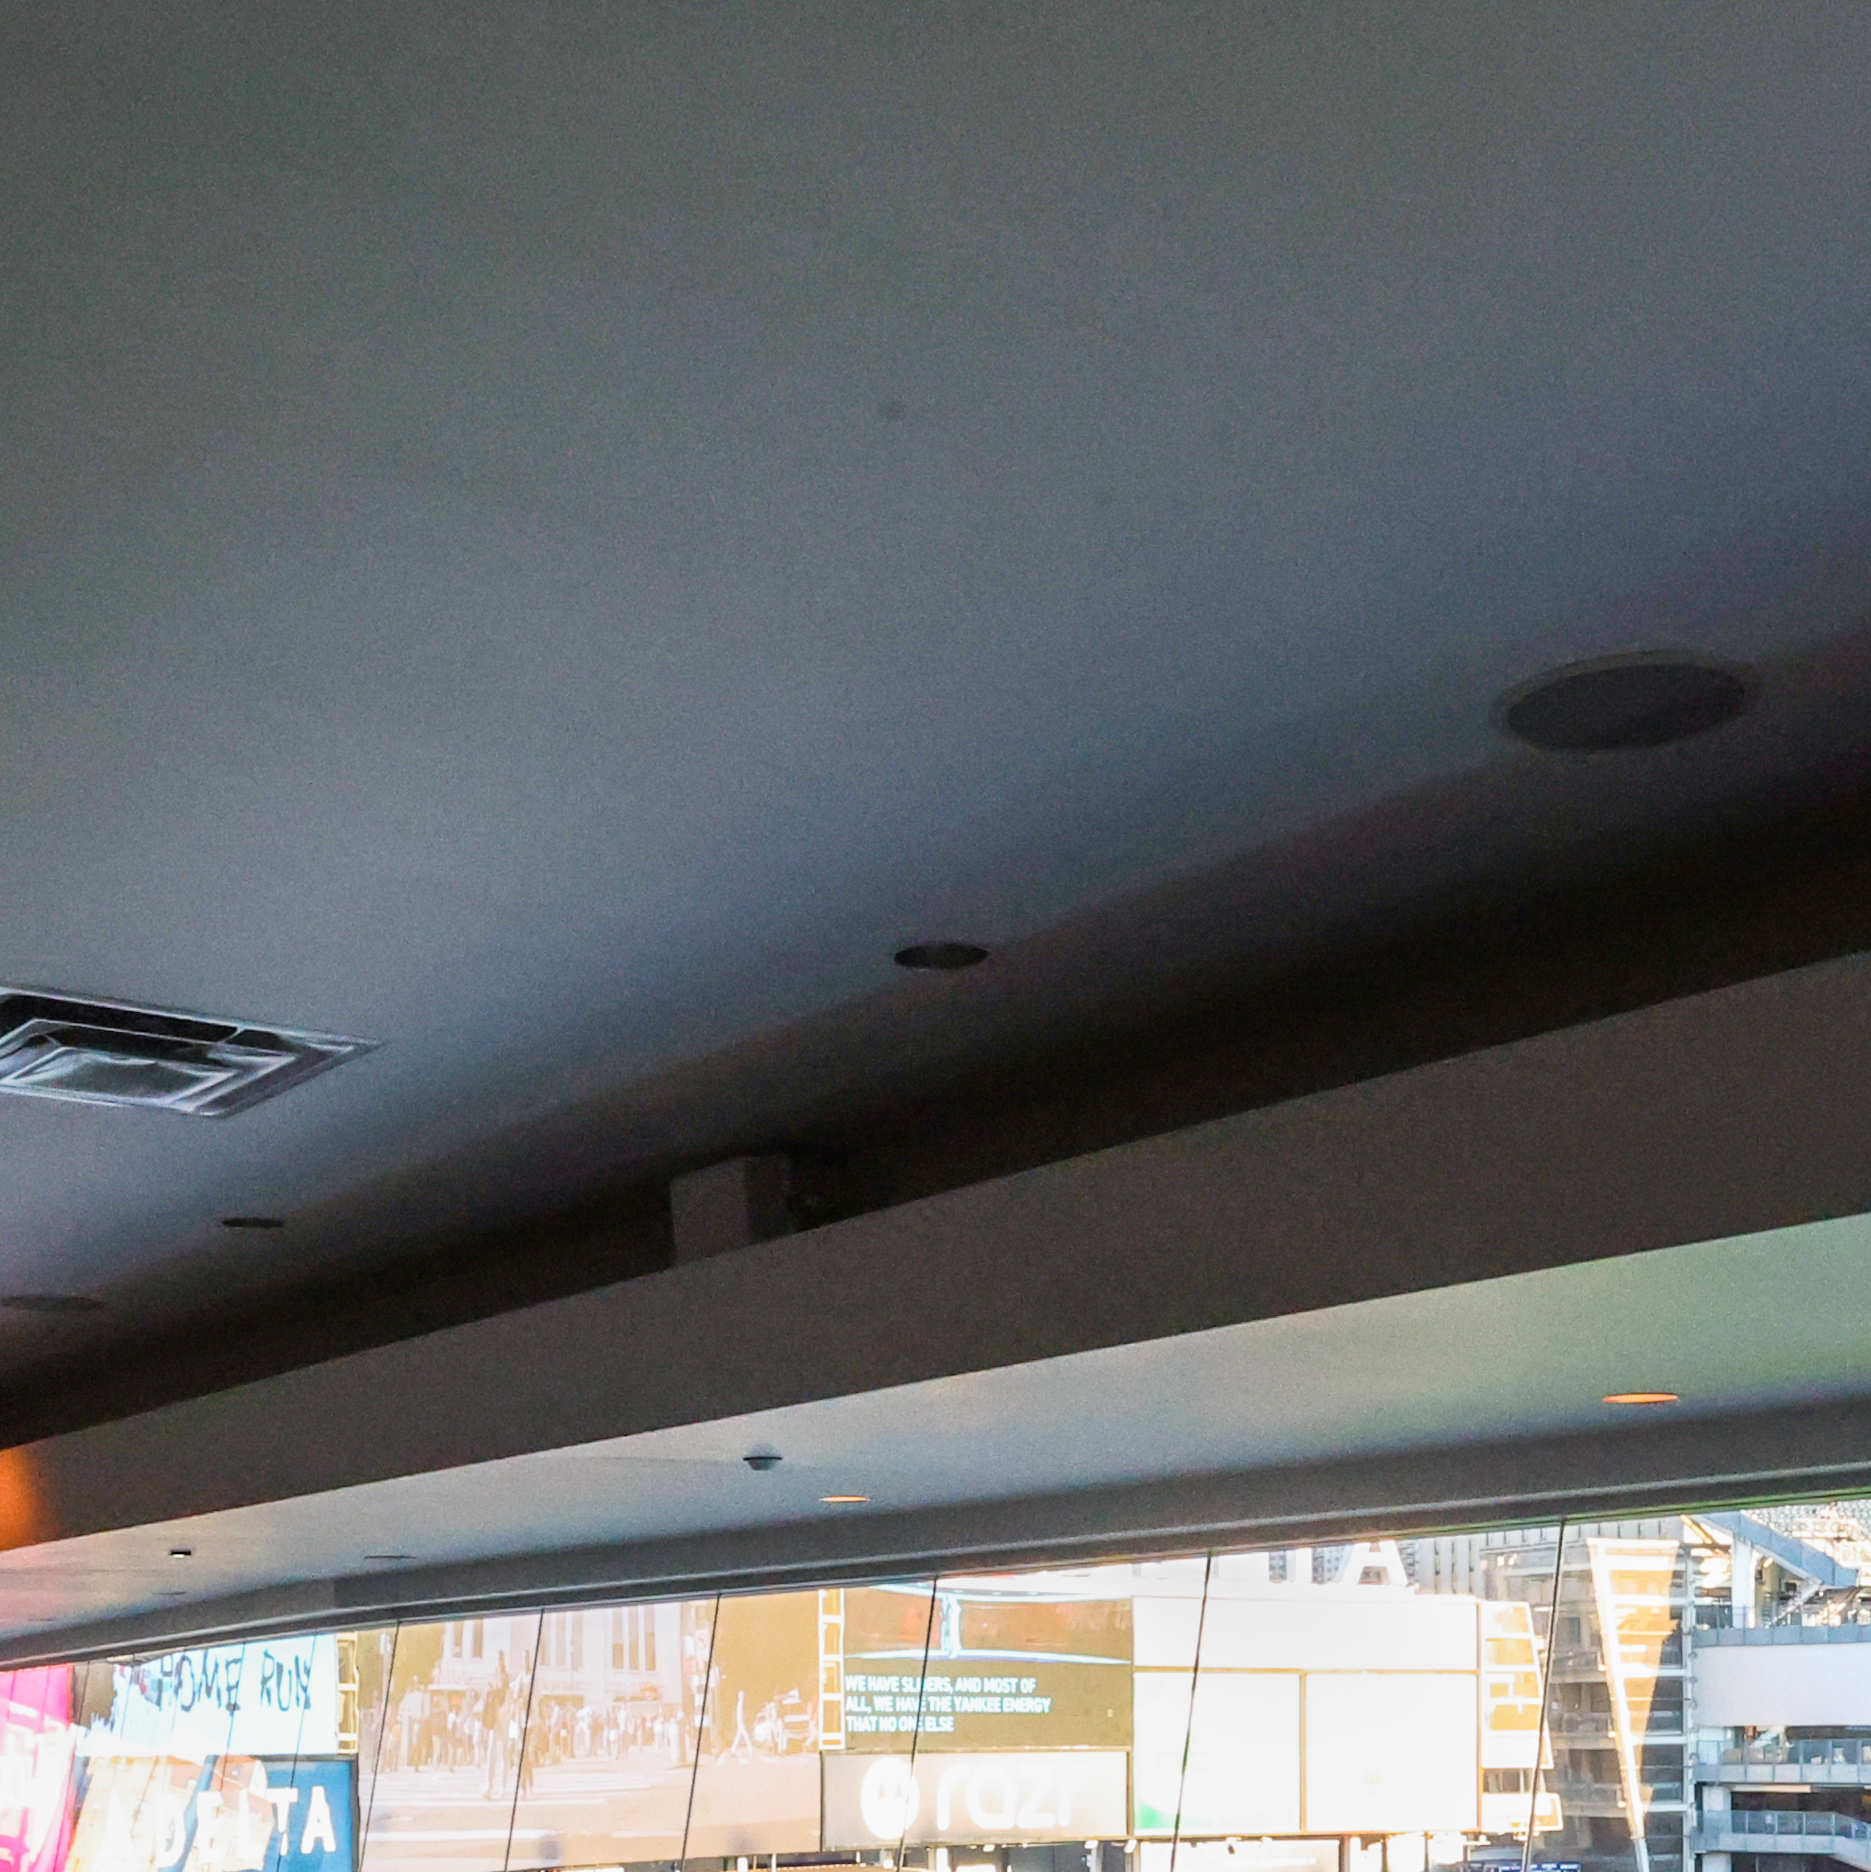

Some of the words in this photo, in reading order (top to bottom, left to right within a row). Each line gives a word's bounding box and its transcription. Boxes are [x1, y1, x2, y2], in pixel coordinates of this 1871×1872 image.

[157, 1650, 242, 1712] HOME
[260, 1648, 312, 1712] RUN
[845, 1676, 867, 1692] WE
[868, 1676, 899, 1693] HAVE
[955, 1677, 982, 1693] AND
[983, 1677, 1018, 1693] MOST
[1020, 1677, 1037, 1693] OF
[845, 1696, 872, 1714] ALL,
[873, 1696, 894, 1713] WE
[896, 1696, 926, 1713] HAVE
[928, 1697, 952, 1713] THE
[954, 1697, 1002, 1713] YANKEE
[1003, 1697, 1052, 1714] ENERGY
[846, 1715, 878, 1732] THAT
[879, 1715, 896, 1731] NO
[898, 1715, 924, 1732] ONE
[925, 1715, 955, 1732] ELSE
[935, 1761, 1090, 1832] razr
[157, 1785, 337, 1870] DELTA
